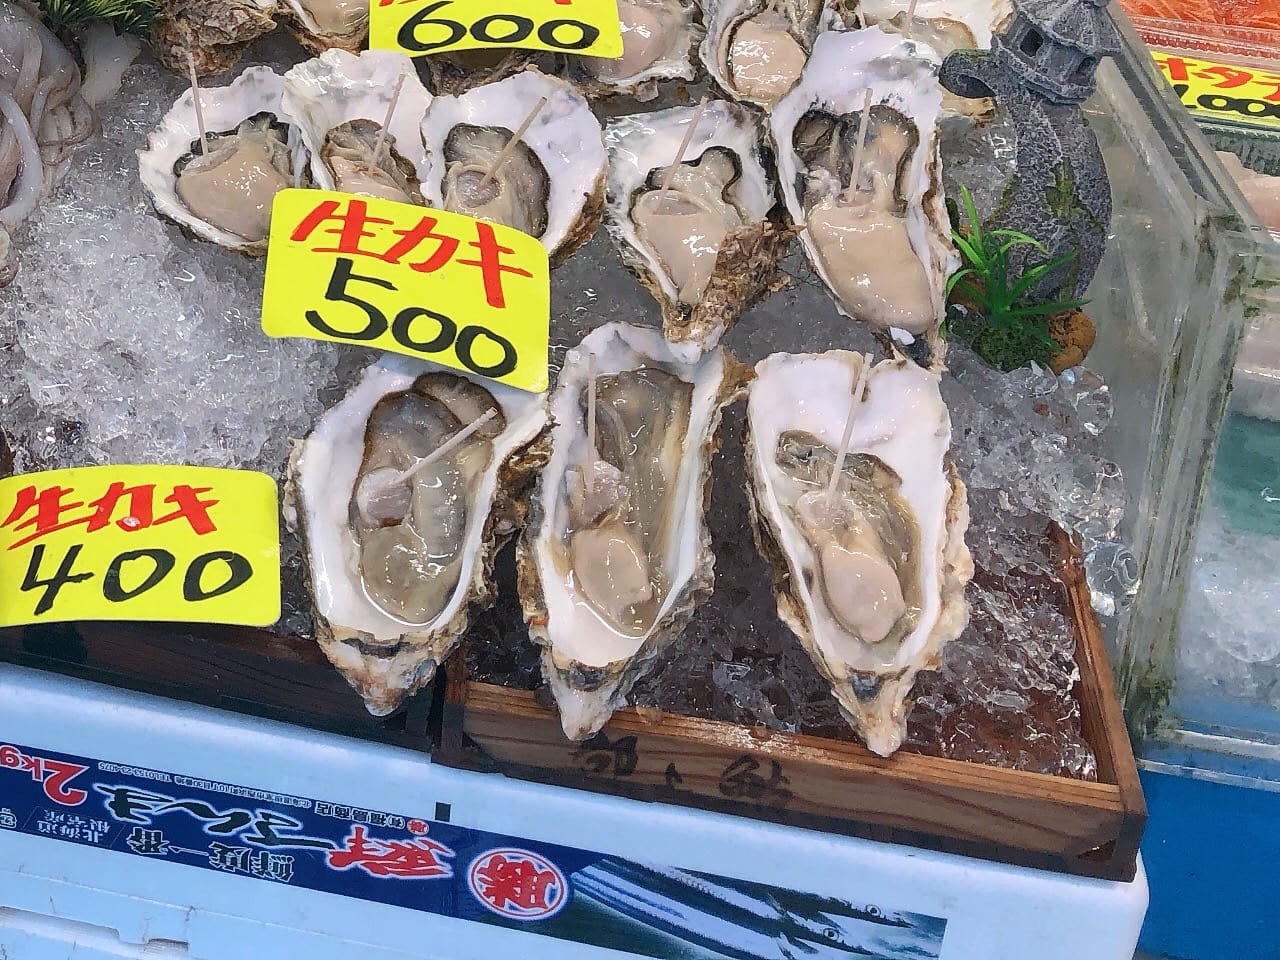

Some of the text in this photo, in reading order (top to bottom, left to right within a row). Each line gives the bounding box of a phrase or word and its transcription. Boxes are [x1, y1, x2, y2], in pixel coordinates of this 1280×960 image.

[397, 0, 600, 52] 600
[290, 200, 534, 309] 生カキ
[305, 257, 518, 377] 500
[0, 481, 220, 550] 生カキ
[20, 544, 254, 616] 400
